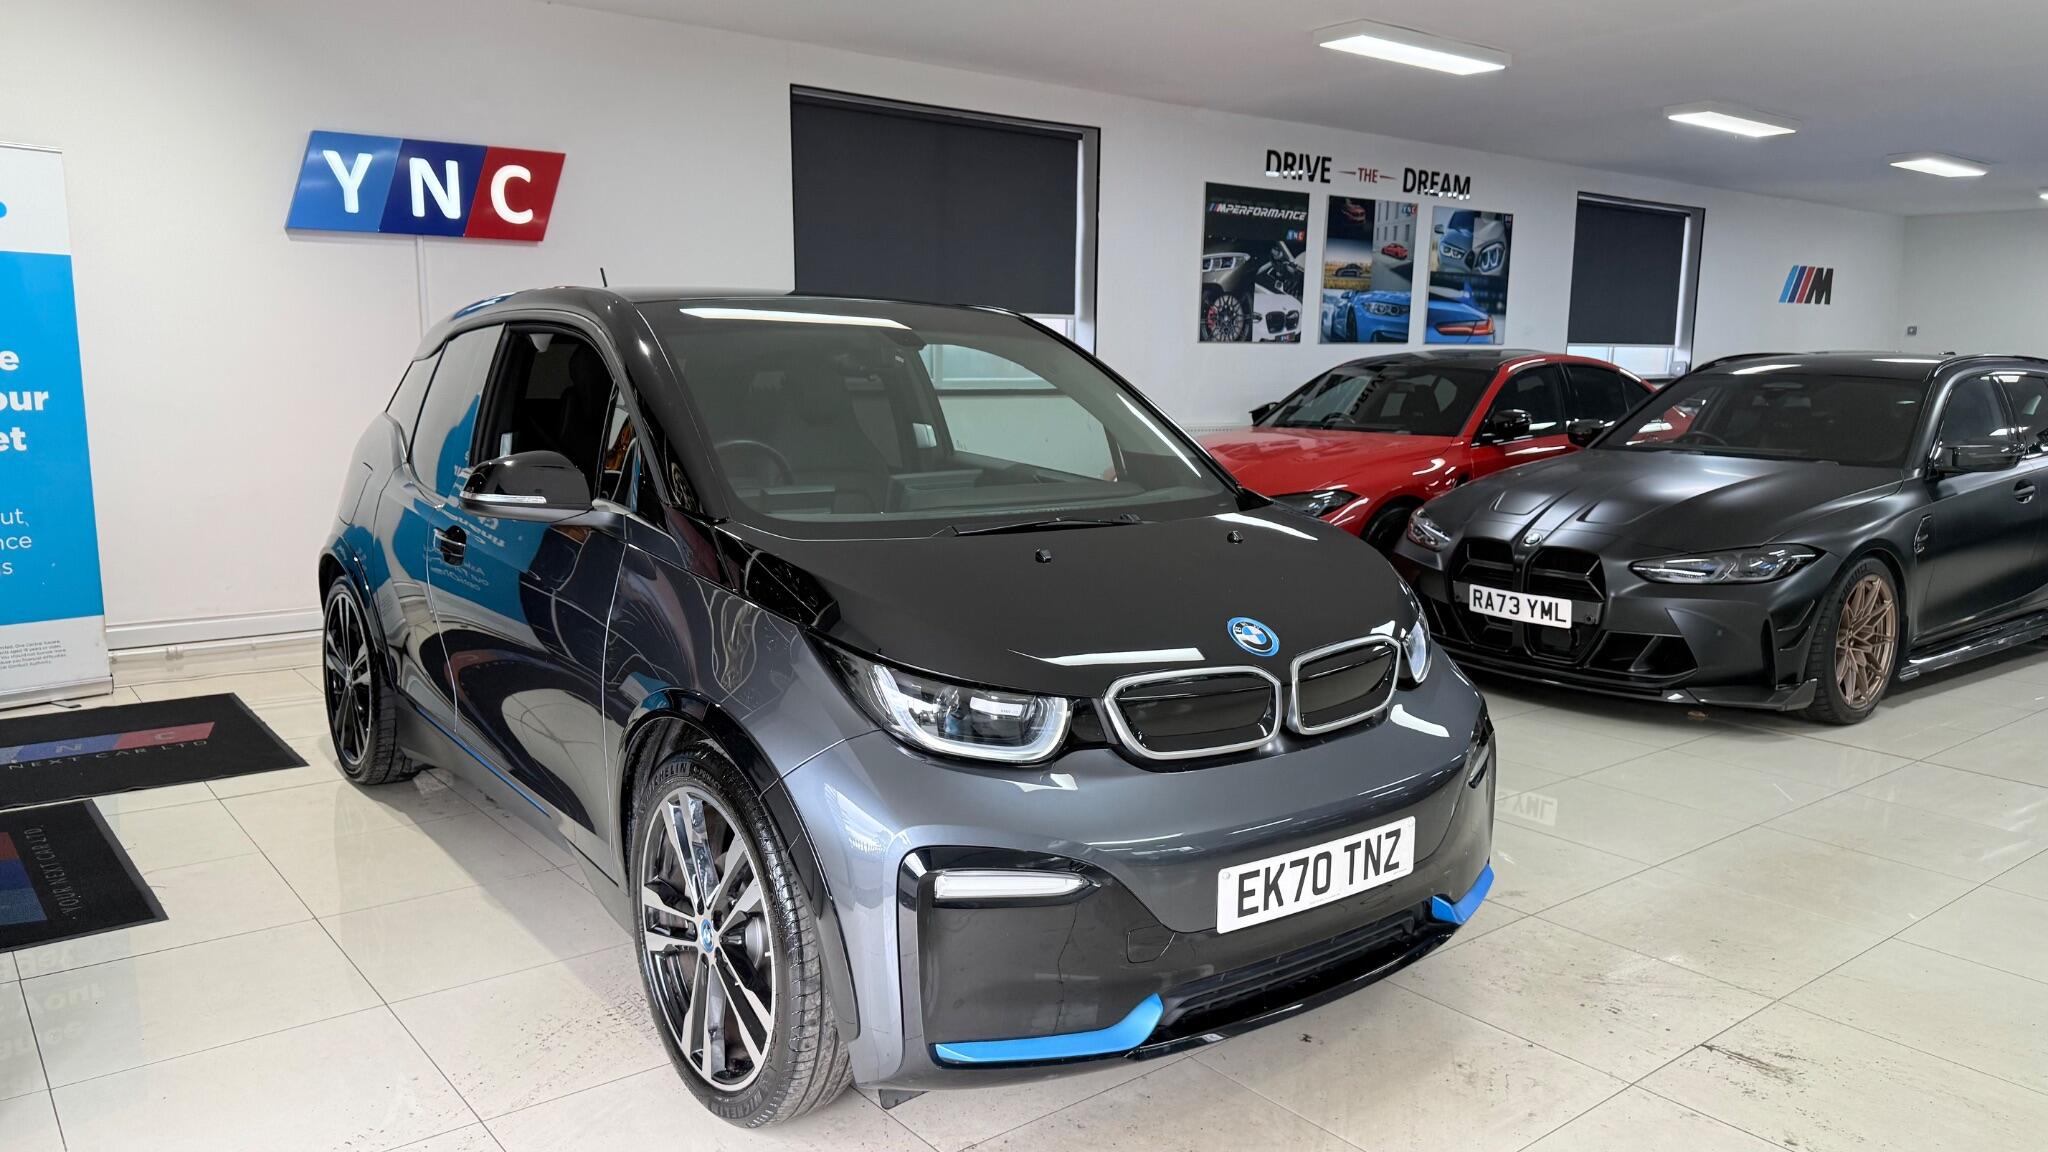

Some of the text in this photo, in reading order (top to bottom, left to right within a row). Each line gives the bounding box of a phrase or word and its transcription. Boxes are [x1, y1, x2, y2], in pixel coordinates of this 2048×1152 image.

[322, 149, 534, 225] YNC
[1265, 149, 1471, 200] DRIVE THE DREAM
[1473, 588, 1567, 623] RA73 YML
[8, 740, 207, 771] NEXT CAR LTD
[31, 844, 56, 861] CAR
[40, 863, 68, 885] NEXT
[1237, 827, 1402, 919] EK70 TNZ
[53, 886, 82, 914] YOUR
